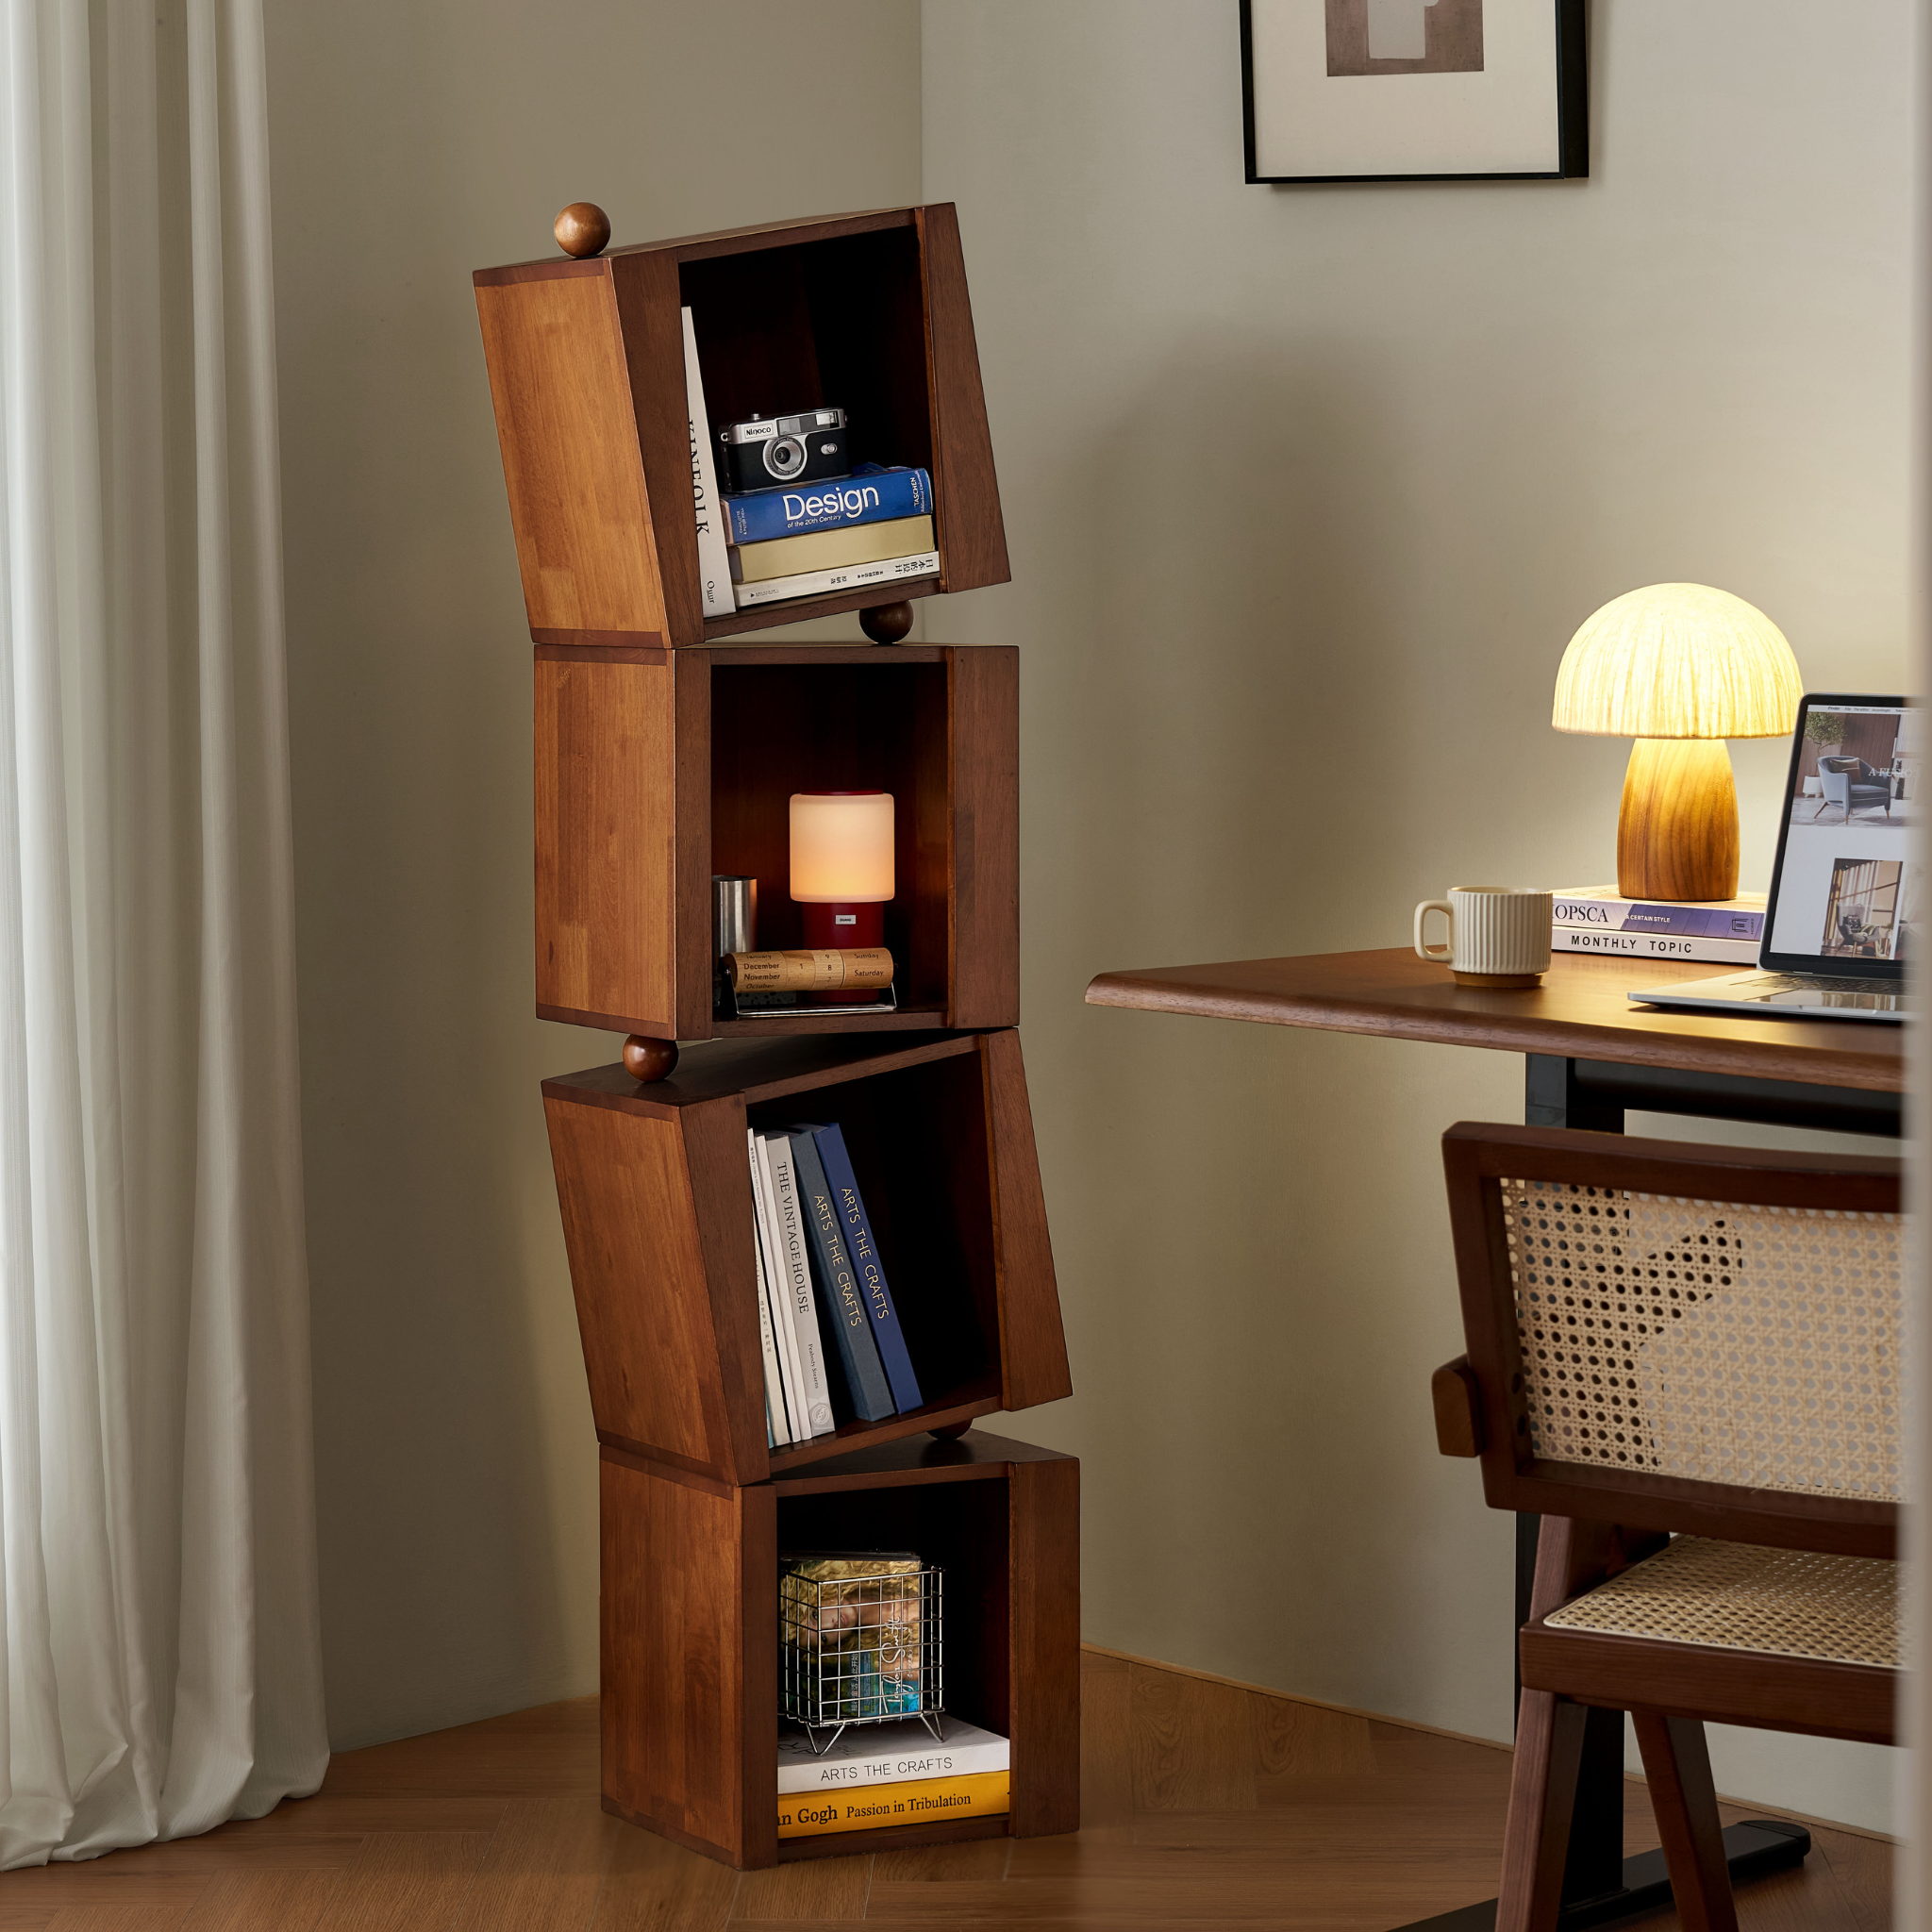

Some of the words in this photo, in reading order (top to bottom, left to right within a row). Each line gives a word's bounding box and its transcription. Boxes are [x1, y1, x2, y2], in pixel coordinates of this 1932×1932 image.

[689, 420, 710, 535] FOLK
[783, 487, 879, 521] Design
[909, 477, 920, 507] TASCHEN
[819, 514, 841, 523] Century
[1868, 767, 1876, 776] A
[1553, 904, 1609, 923] OPSCA
[1571, 935, 1637, 949] MONTHLY
[1650, 941, 1692, 954] TOPIC
[854, 969, 884, 977] Saturday
[776, 1161, 791, 1193] THE
[814, 1195, 834, 1231] ARTS
[825, 1235, 844, 1267] THE
[837, 1272, 862, 1326] CRAFTS
[841, 1188, 861, 1224] ARTS
[854, 1227, 872, 1258] THE
[864, 1264, 889, 1320] CRAFTS
[808, 1343, 816, 1367] Peabody
[820, 1766, 858, 1782] ARTS
[863, 1763, 891, 1777] THE
[897, 1757, 953, 1774] CRAFTS
[797, 1805, 838, 1825] Gogh
[846, 1803, 891, 1818] Passion
[893, 1800, 906, 1812] in
[907, 1793, 972, 1811] Tribulation
